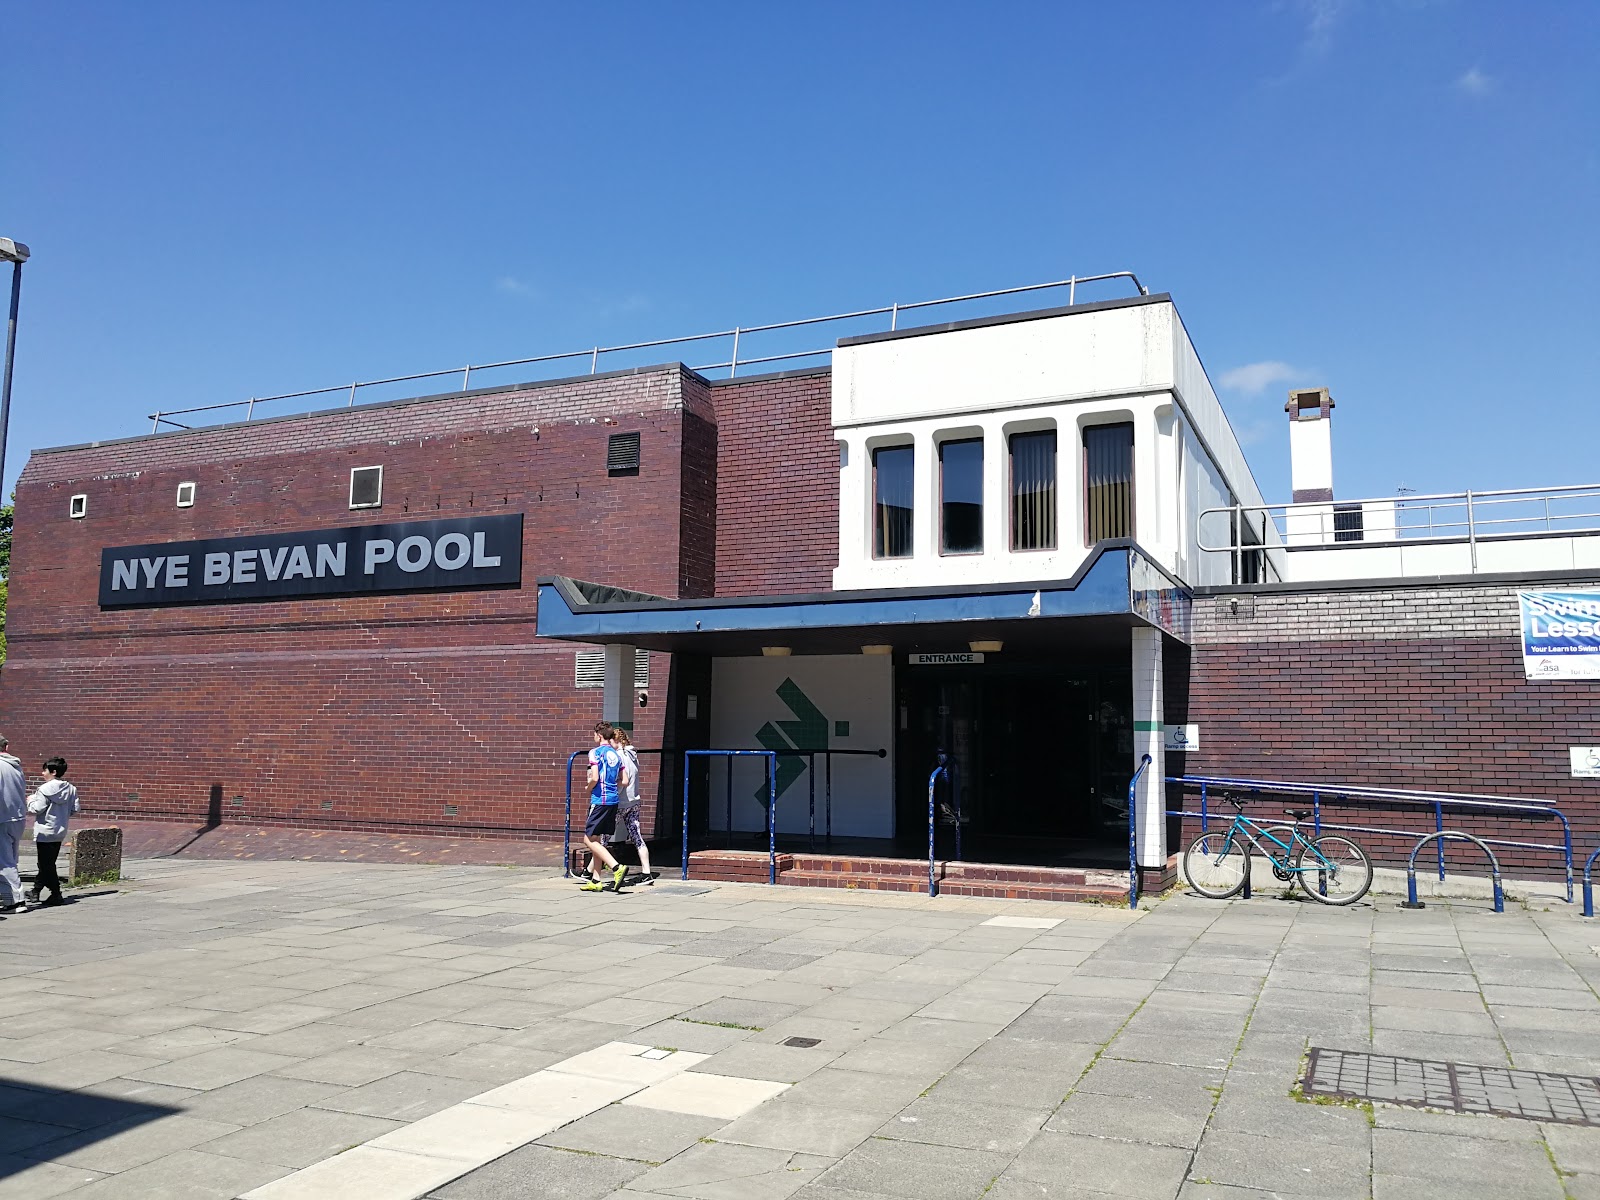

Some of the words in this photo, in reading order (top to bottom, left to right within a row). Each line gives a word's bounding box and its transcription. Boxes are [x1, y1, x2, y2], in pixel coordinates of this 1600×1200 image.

[111, 555, 189, 590] NYE
[203, 542, 347, 585] BEVAN
[364, 532, 501, 574] POOL
[919, 654, 973, 663] ENTRANCE
